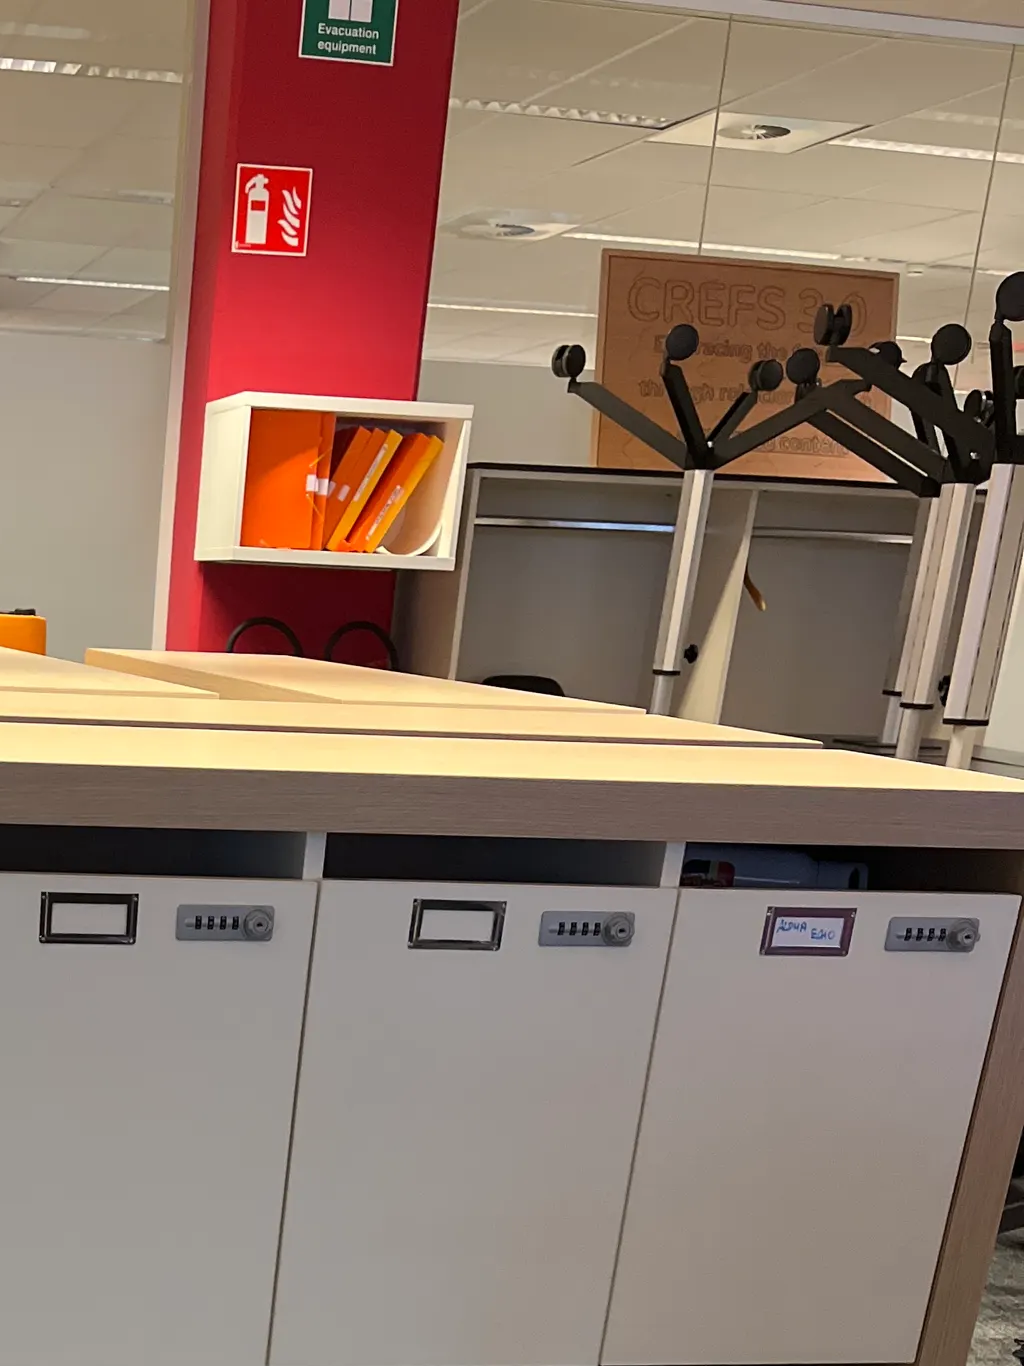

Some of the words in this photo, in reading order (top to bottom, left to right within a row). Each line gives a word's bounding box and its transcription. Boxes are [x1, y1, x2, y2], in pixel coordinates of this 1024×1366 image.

[317, 23, 379, 40] Evacuation
[317, 40, 376, 54] equipment
[627, 276, 786, 331] CREFS
[797, 287, 868, 337] 30
[654, 335, 753, 363] Eracing
[756, 341, 789, 360] the
[638, 379, 715, 404] thgh
